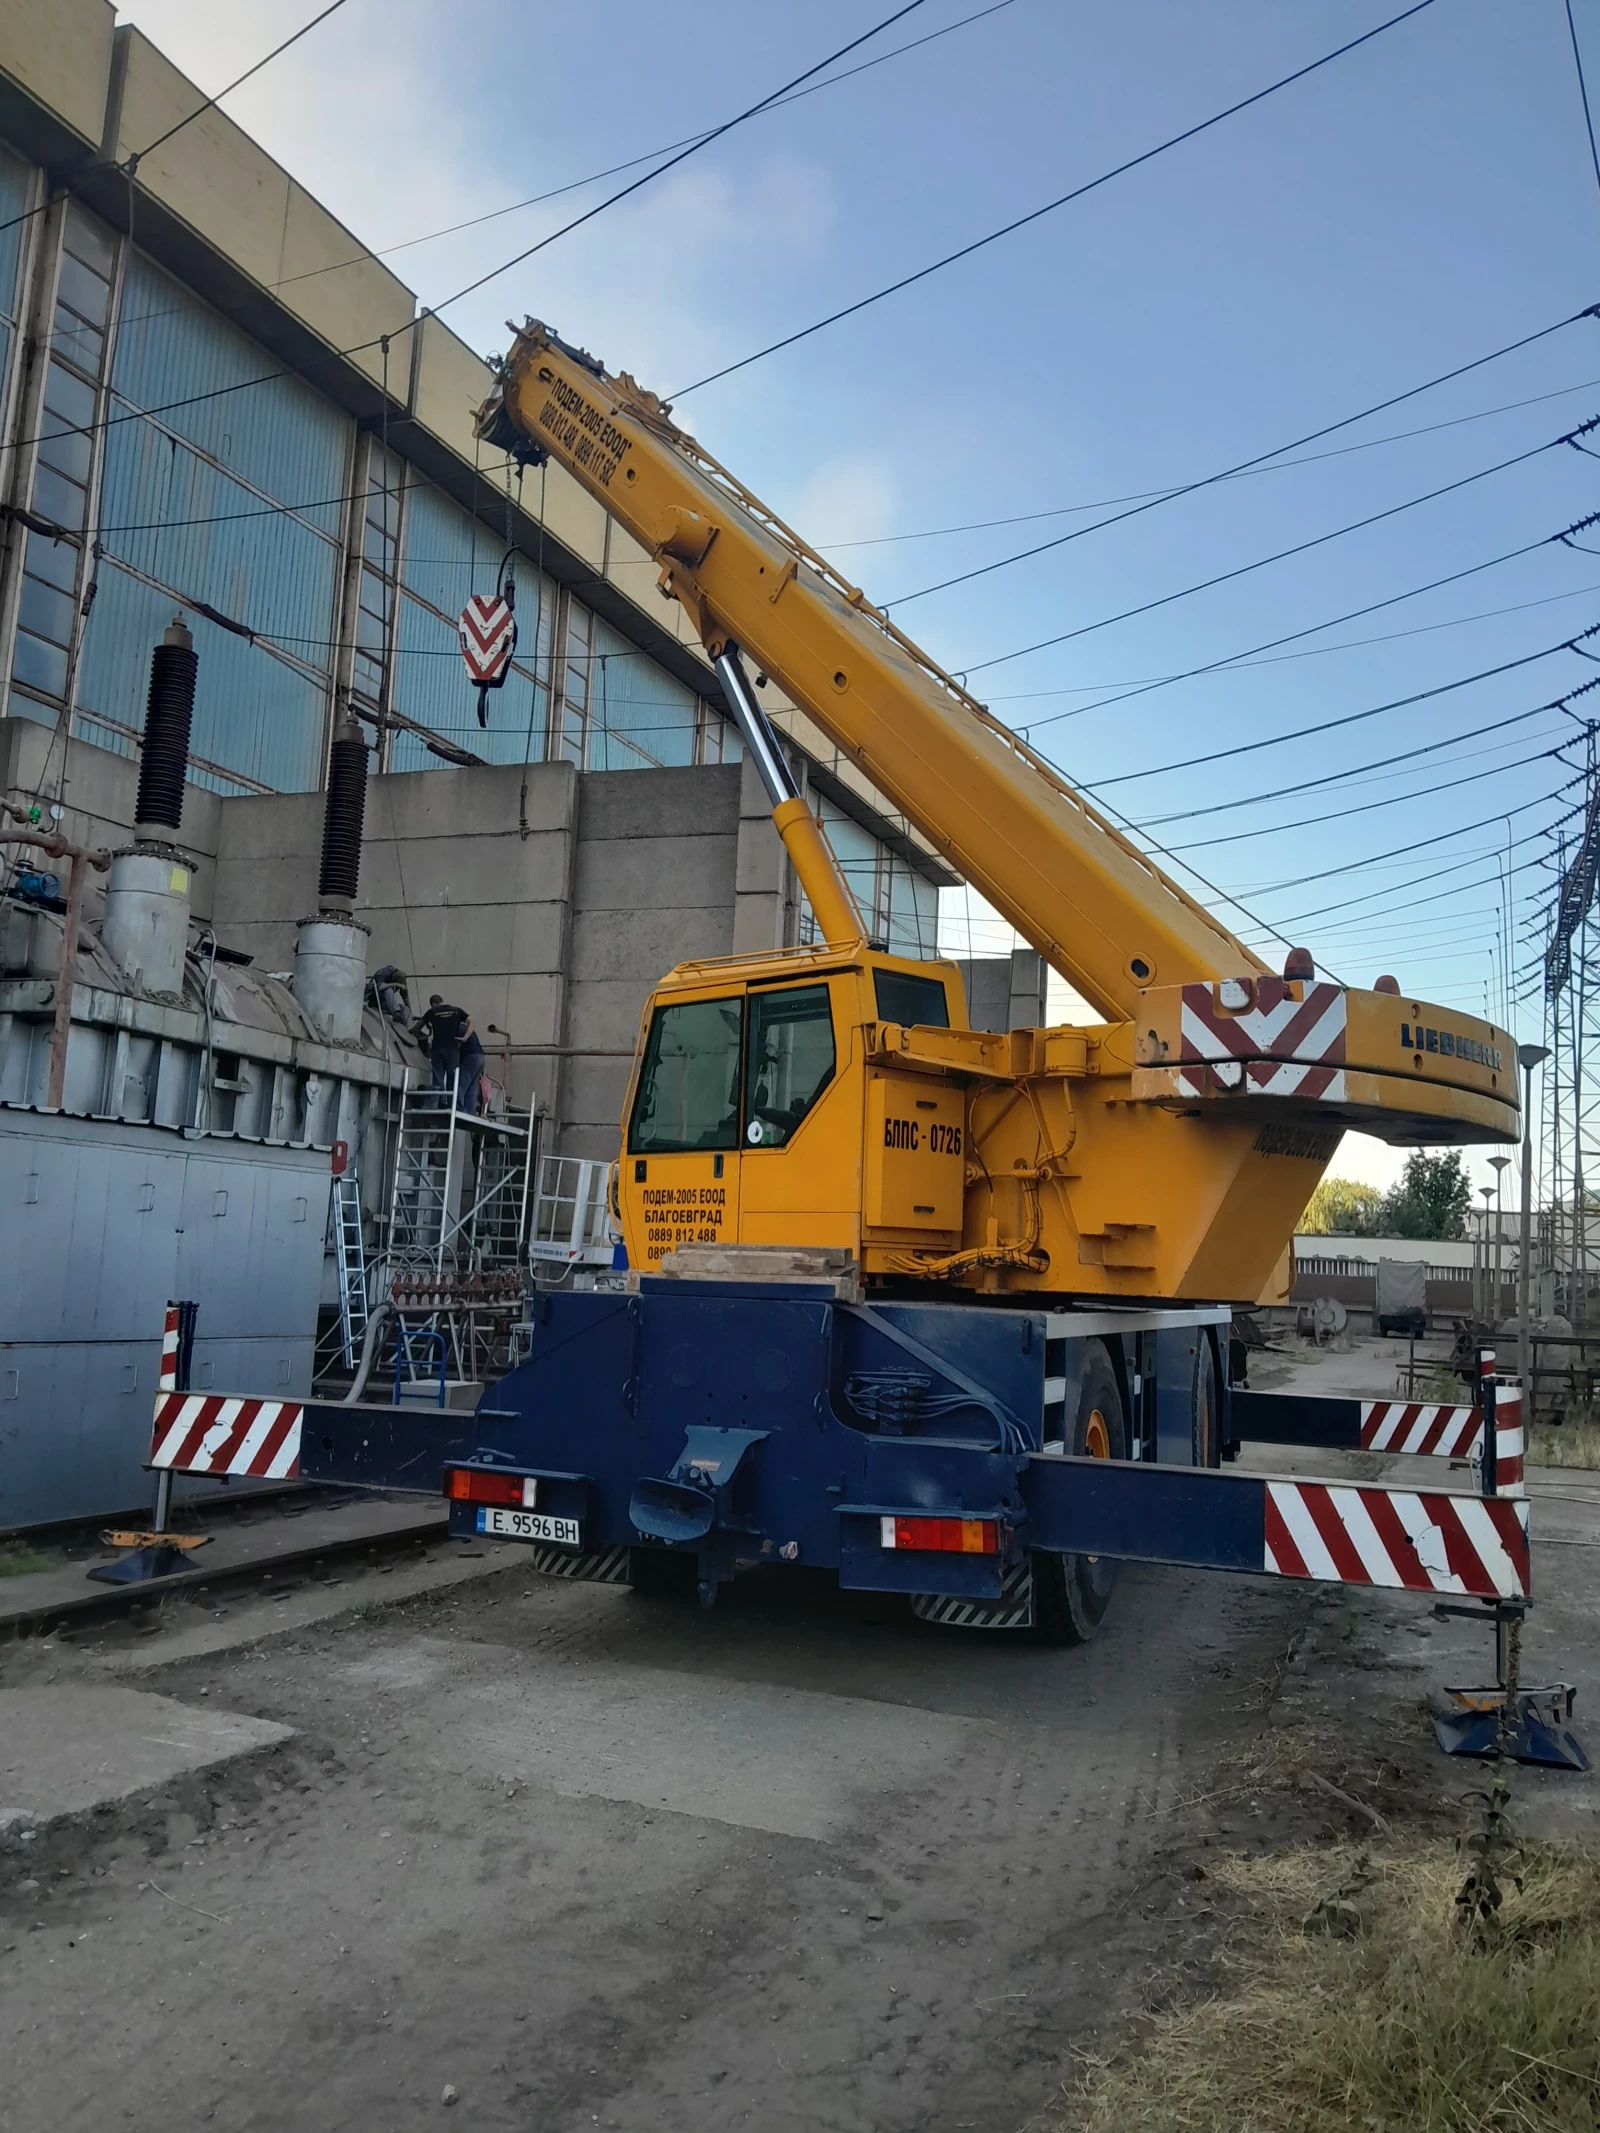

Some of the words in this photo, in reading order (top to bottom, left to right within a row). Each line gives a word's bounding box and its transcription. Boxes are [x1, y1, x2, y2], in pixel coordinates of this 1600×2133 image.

[551, 377, 604, 436] ПОДЕМ-2005
[600, 423, 629, 463] ЕООД
[552, 413, 568, 441] 812
[563, 423, 579, 450] 488
[589, 448, 605, 475] 117
[1401, 1023, 1502, 1072] LIEBHERR
[884, 1118, 919, 1150] БЛПС
[931, 1124, 961, 1155] 0726
[643, 1189, 697, 1206] ПОДЕМ-2005
[699, 1188, 726, 1206] ЕООД
[644, 1210, 722, 1226] БЛАГОЕВГРАД
[648, 1228, 672, 1241] 0889
[675, 1228, 694, 1242] 812
[697, 1229, 716, 1242] 488
[512, 1514, 551, 1537] 9596
[554, 1520, 576, 1541] BH
